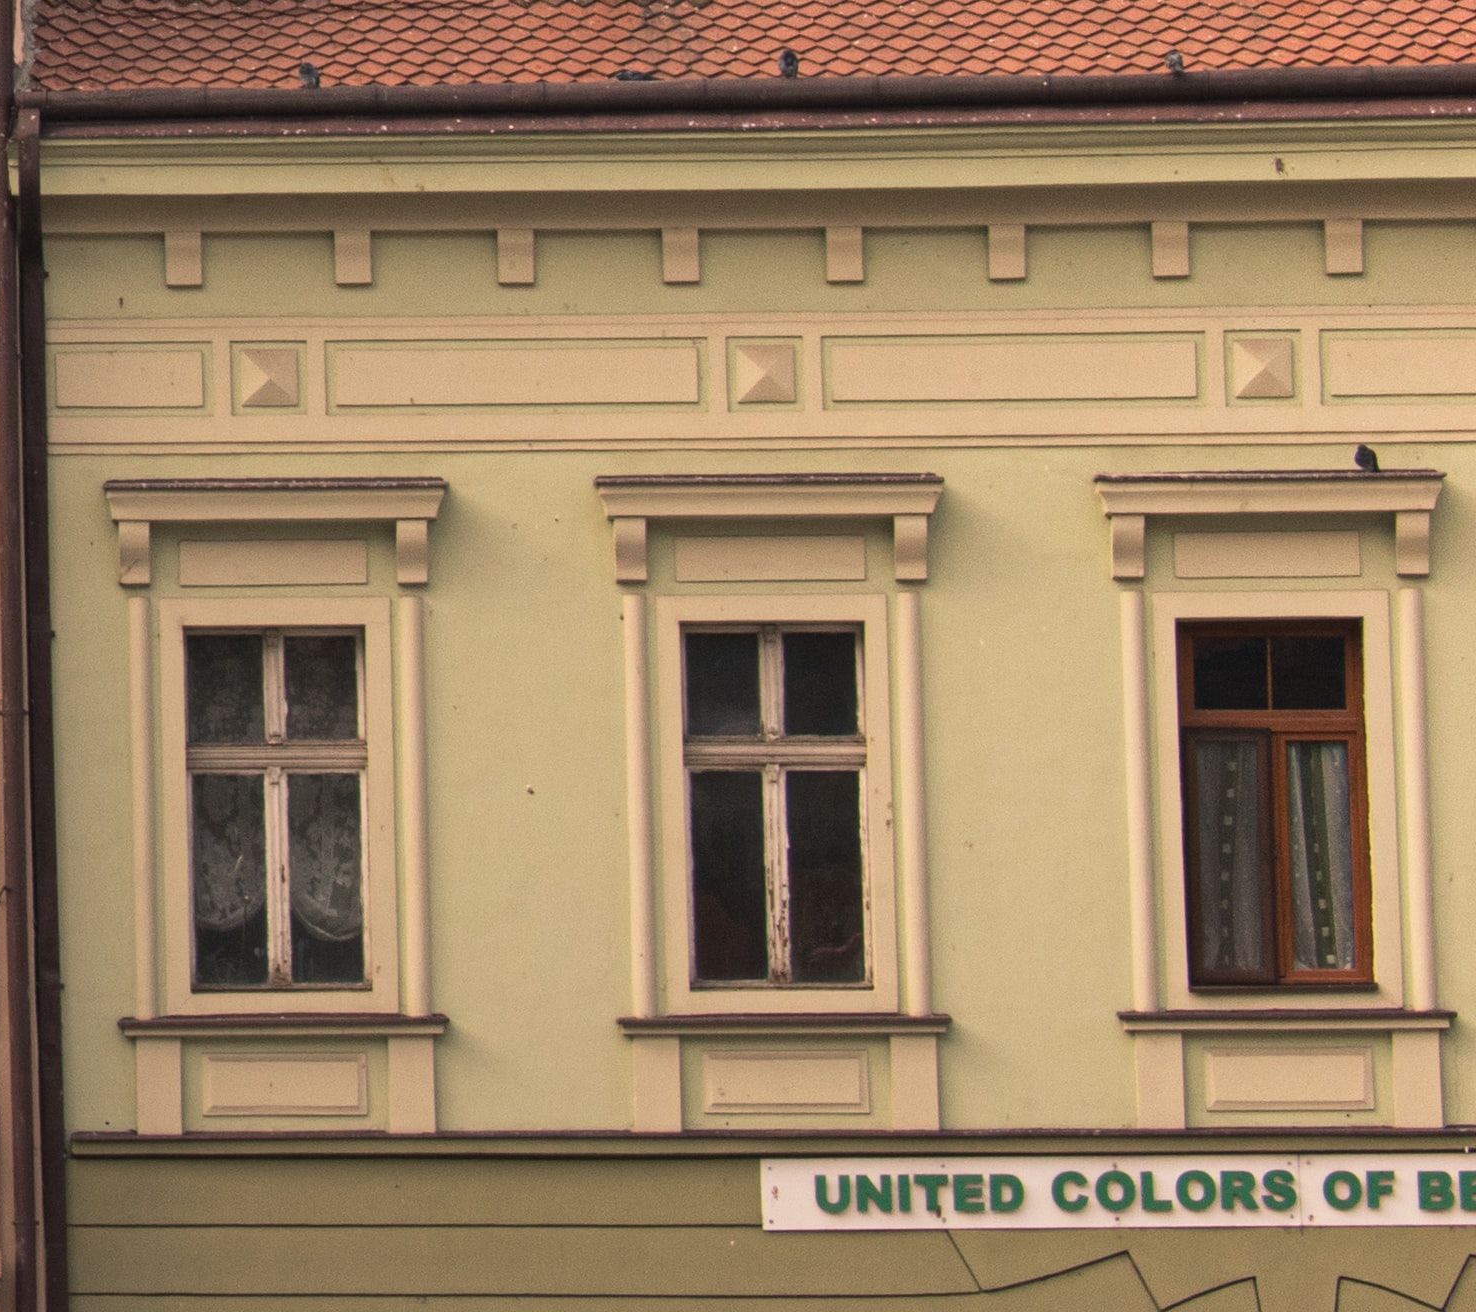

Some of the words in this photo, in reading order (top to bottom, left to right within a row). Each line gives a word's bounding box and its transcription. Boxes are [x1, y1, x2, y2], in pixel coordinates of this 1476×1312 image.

[814, 1175, 1025, 1213] UNITED
[1051, 1170, 1298, 1212] COLORS
[1323, 1171, 1394, 1210] OF
